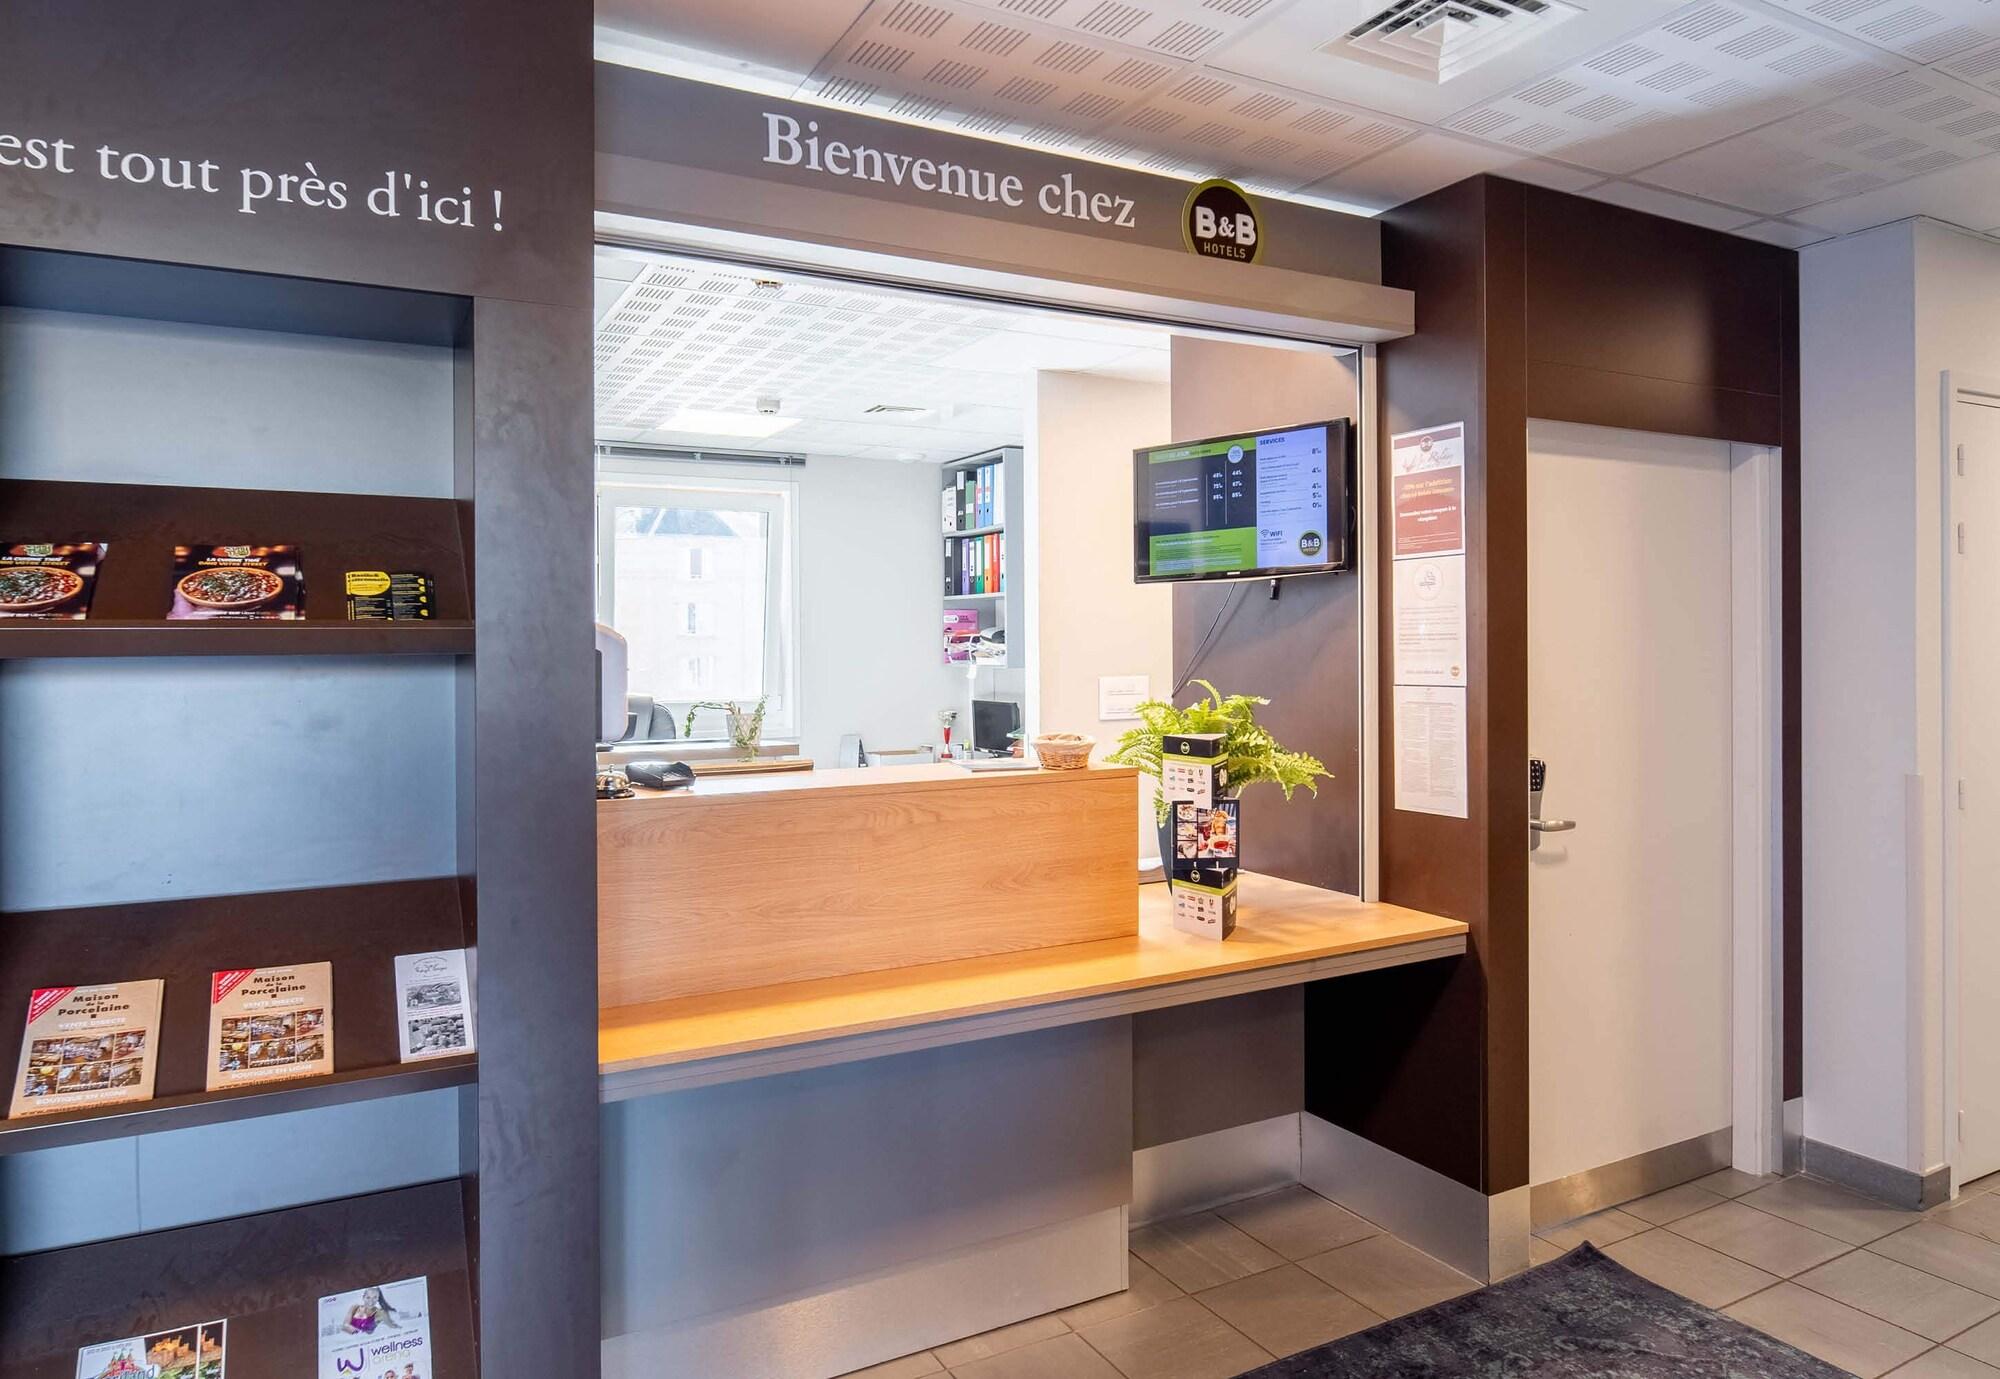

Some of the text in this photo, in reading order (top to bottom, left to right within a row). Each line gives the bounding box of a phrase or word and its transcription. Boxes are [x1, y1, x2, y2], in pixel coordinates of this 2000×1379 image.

[762, 112, 1136, 228] Bienvenue chez
[96, 144, 219, 193] tout
[239, 162, 348, 214] près
[367, 171, 475, 228] d'ici
[1195, 206, 1257, 247] B&B
[1203, 241, 1247, 260] HOTELS
[1260, 437, 1286, 446] SERVICES
[1301, 537, 1320, 549] B&B
[254, 975, 295, 984] Maison
[241, 984, 307, 996] Porcelaine
[72, 993, 119, 1003] Maison
[58, 1003, 130, 1016] Porcelaine
[371, 1337, 423, 1356] wellness
